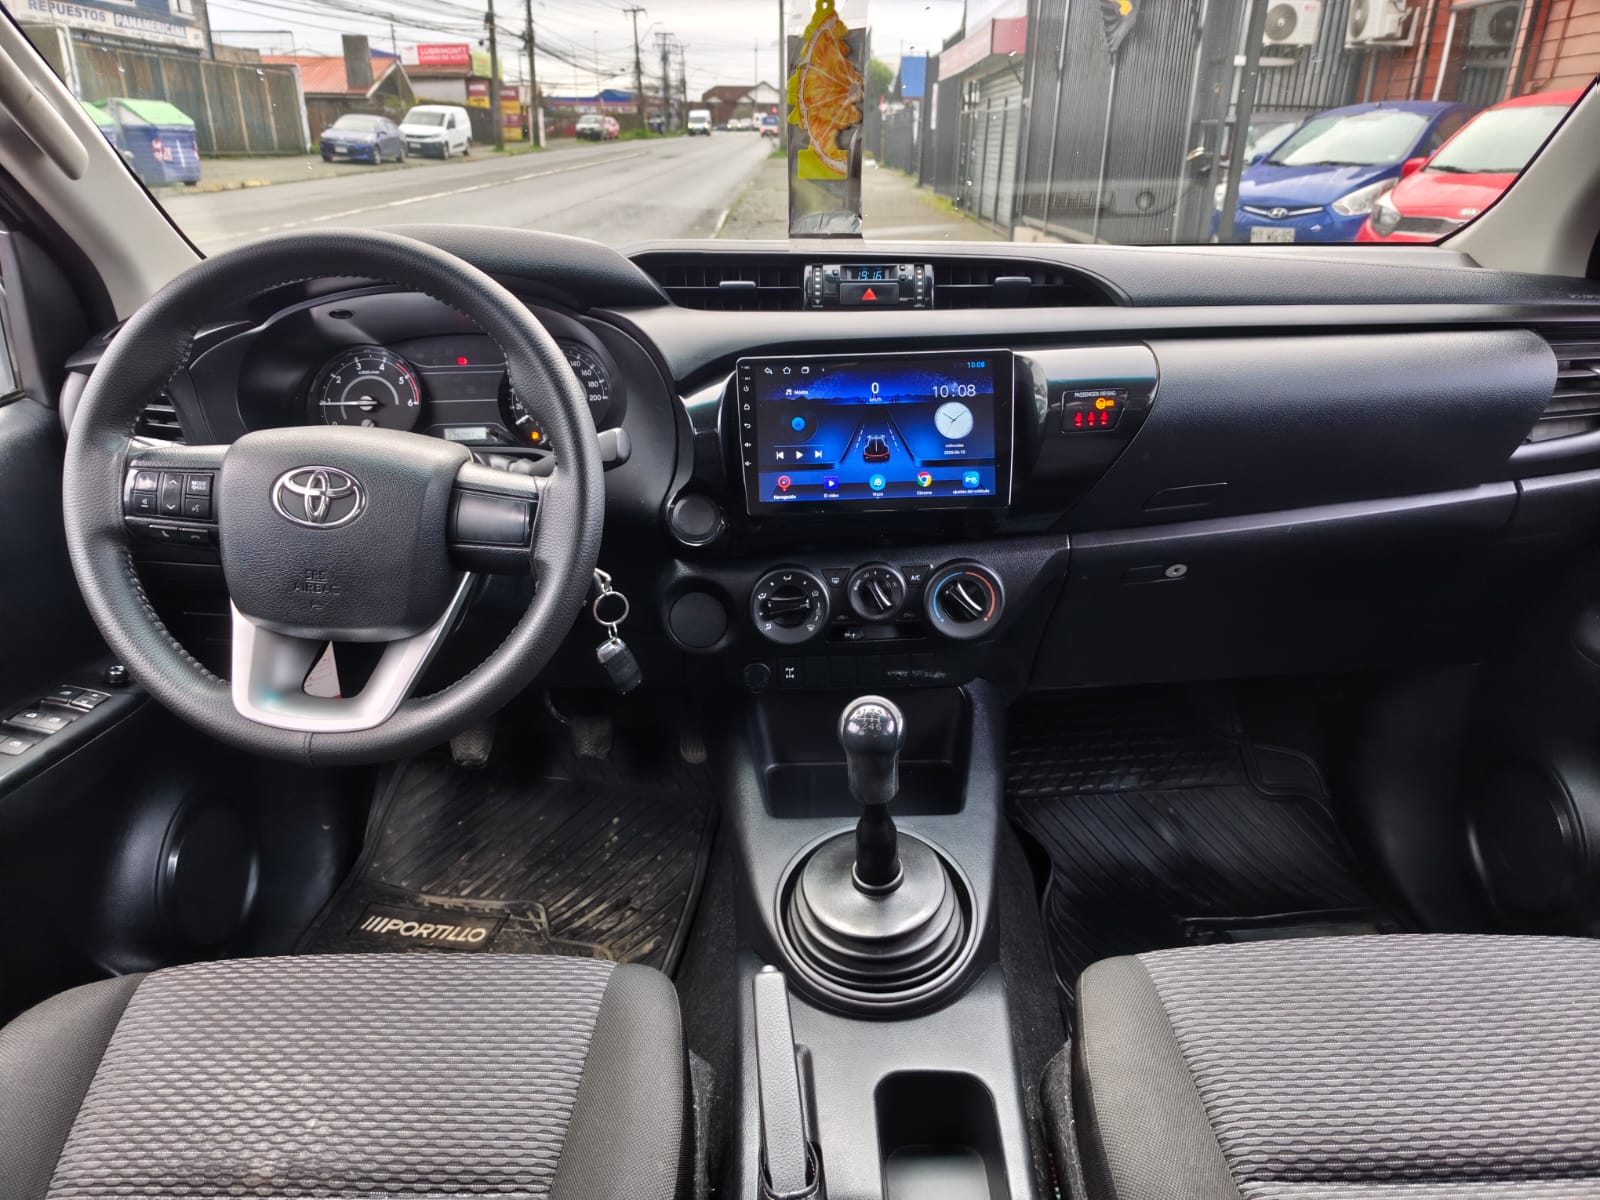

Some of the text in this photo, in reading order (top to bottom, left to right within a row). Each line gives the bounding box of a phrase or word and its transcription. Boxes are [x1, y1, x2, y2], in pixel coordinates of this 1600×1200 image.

[28, 0, 106, 22] REPUESTOS
[379, 363, 385, 371] 4
[967, 361, 986, 369] 10:08
[871, 382, 879, 394] 0
[932, 384, 976, 398] 10:08
[294, 580, 341, 596] AIRBAG
[380, 919, 487, 942] PORTILLO
